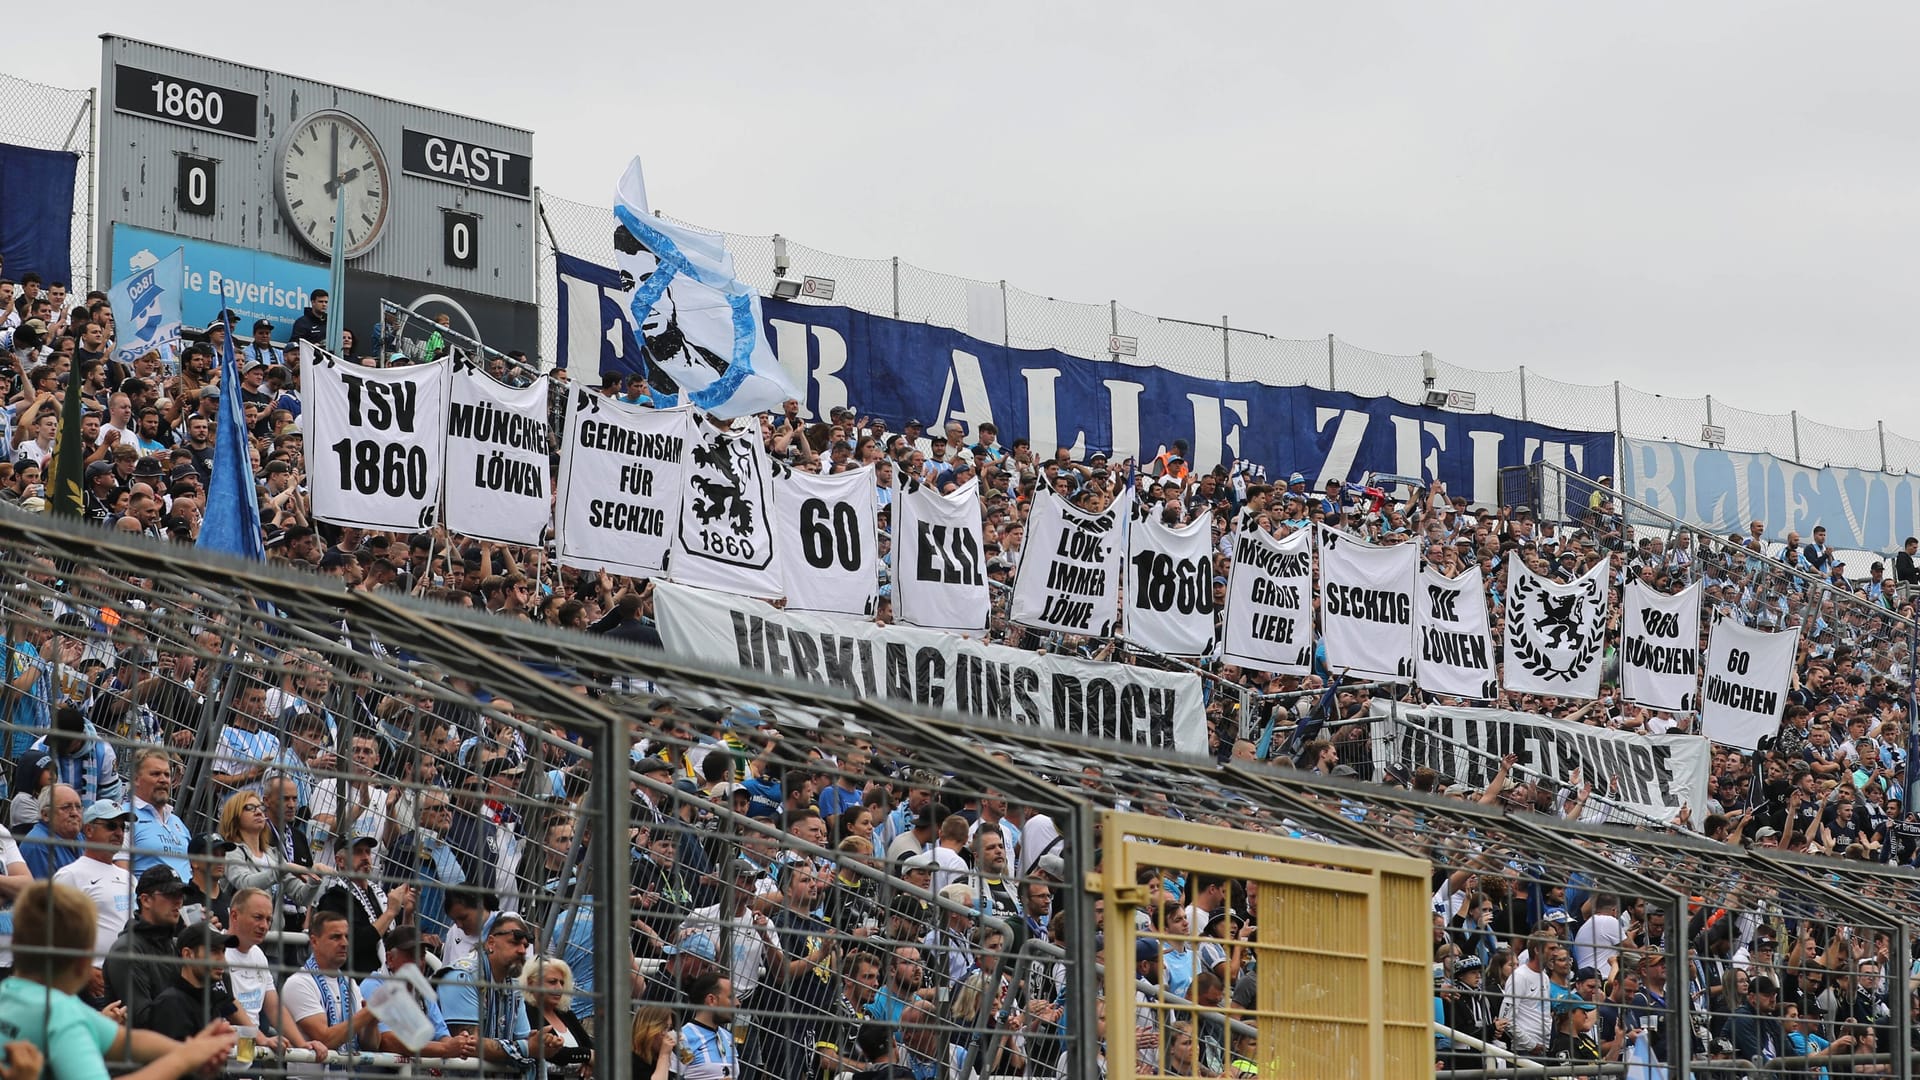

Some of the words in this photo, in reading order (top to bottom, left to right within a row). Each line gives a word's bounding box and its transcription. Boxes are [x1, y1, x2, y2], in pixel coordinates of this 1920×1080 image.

[151, 80, 223, 125] 1860
[424, 137, 510, 187] GAST
[188, 167, 207, 206] 0
[452, 222, 469, 260] 0
[183, 266, 203, 292] ie
[209, 270, 311, 311] Bayerisch
[341, 374, 417, 433] TSV
[580, 420, 683, 464] GEMEINSAM
[926, 349, 1250, 481] ALLE
[1314, 406, 1584, 522] ZEIT
[332, 438, 427, 500] 1860
[475, 450, 542, 498] LÖWEN
[620, 463, 653, 497] FÜR
[589, 499, 664, 537] SECHZIG
[800, 498, 861, 571] 60
[699, 529, 754, 559] 1860
[1047, 560, 1105, 597] IMMER
[1132, 550, 1214, 615] 1860
[1039, 594, 1094, 629] LÖWE
[1326, 582, 1411, 625] SECHZIG
[1428, 584, 1461, 622] DIE
[1641, 607, 1679, 639] 1860
[1252, 613, 1295, 644] LIEBE
[1421, 624, 1489, 670] LÖWEN
[1625, 635, 1695, 675] MÜNCHEN
[1727, 648, 1750, 676] 60
[729, 609, 946, 707] VERKLAG
[956, 653, 1041, 727] UNS
[1052, 673, 1176, 752] DOCH
[1706, 674, 1778, 715] MÜNCHEN
[1466, 719, 1680, 808] LUFTPUMPE
